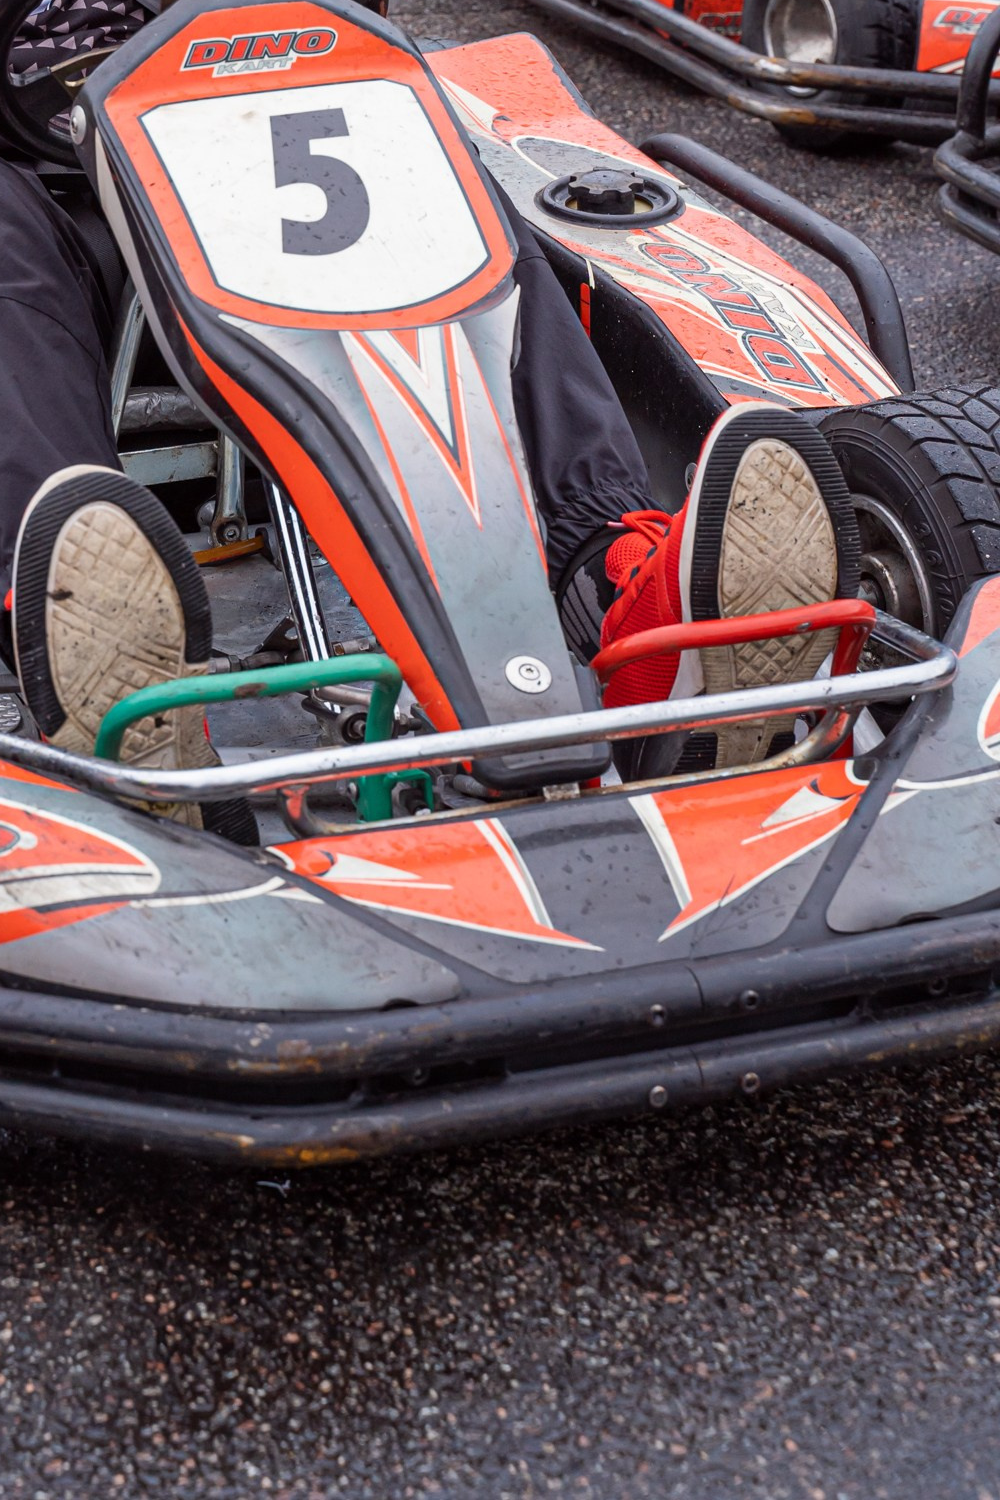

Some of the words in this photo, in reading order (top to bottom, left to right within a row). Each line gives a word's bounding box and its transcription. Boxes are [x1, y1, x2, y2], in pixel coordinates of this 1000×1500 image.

[184, 29, 336, 68] DINO
[216, 57, 294, 75] KART
[269, 107, 370, 256] 5
[639, 242, 828, 392] DINO
[722, 269, 817, 350] KART
